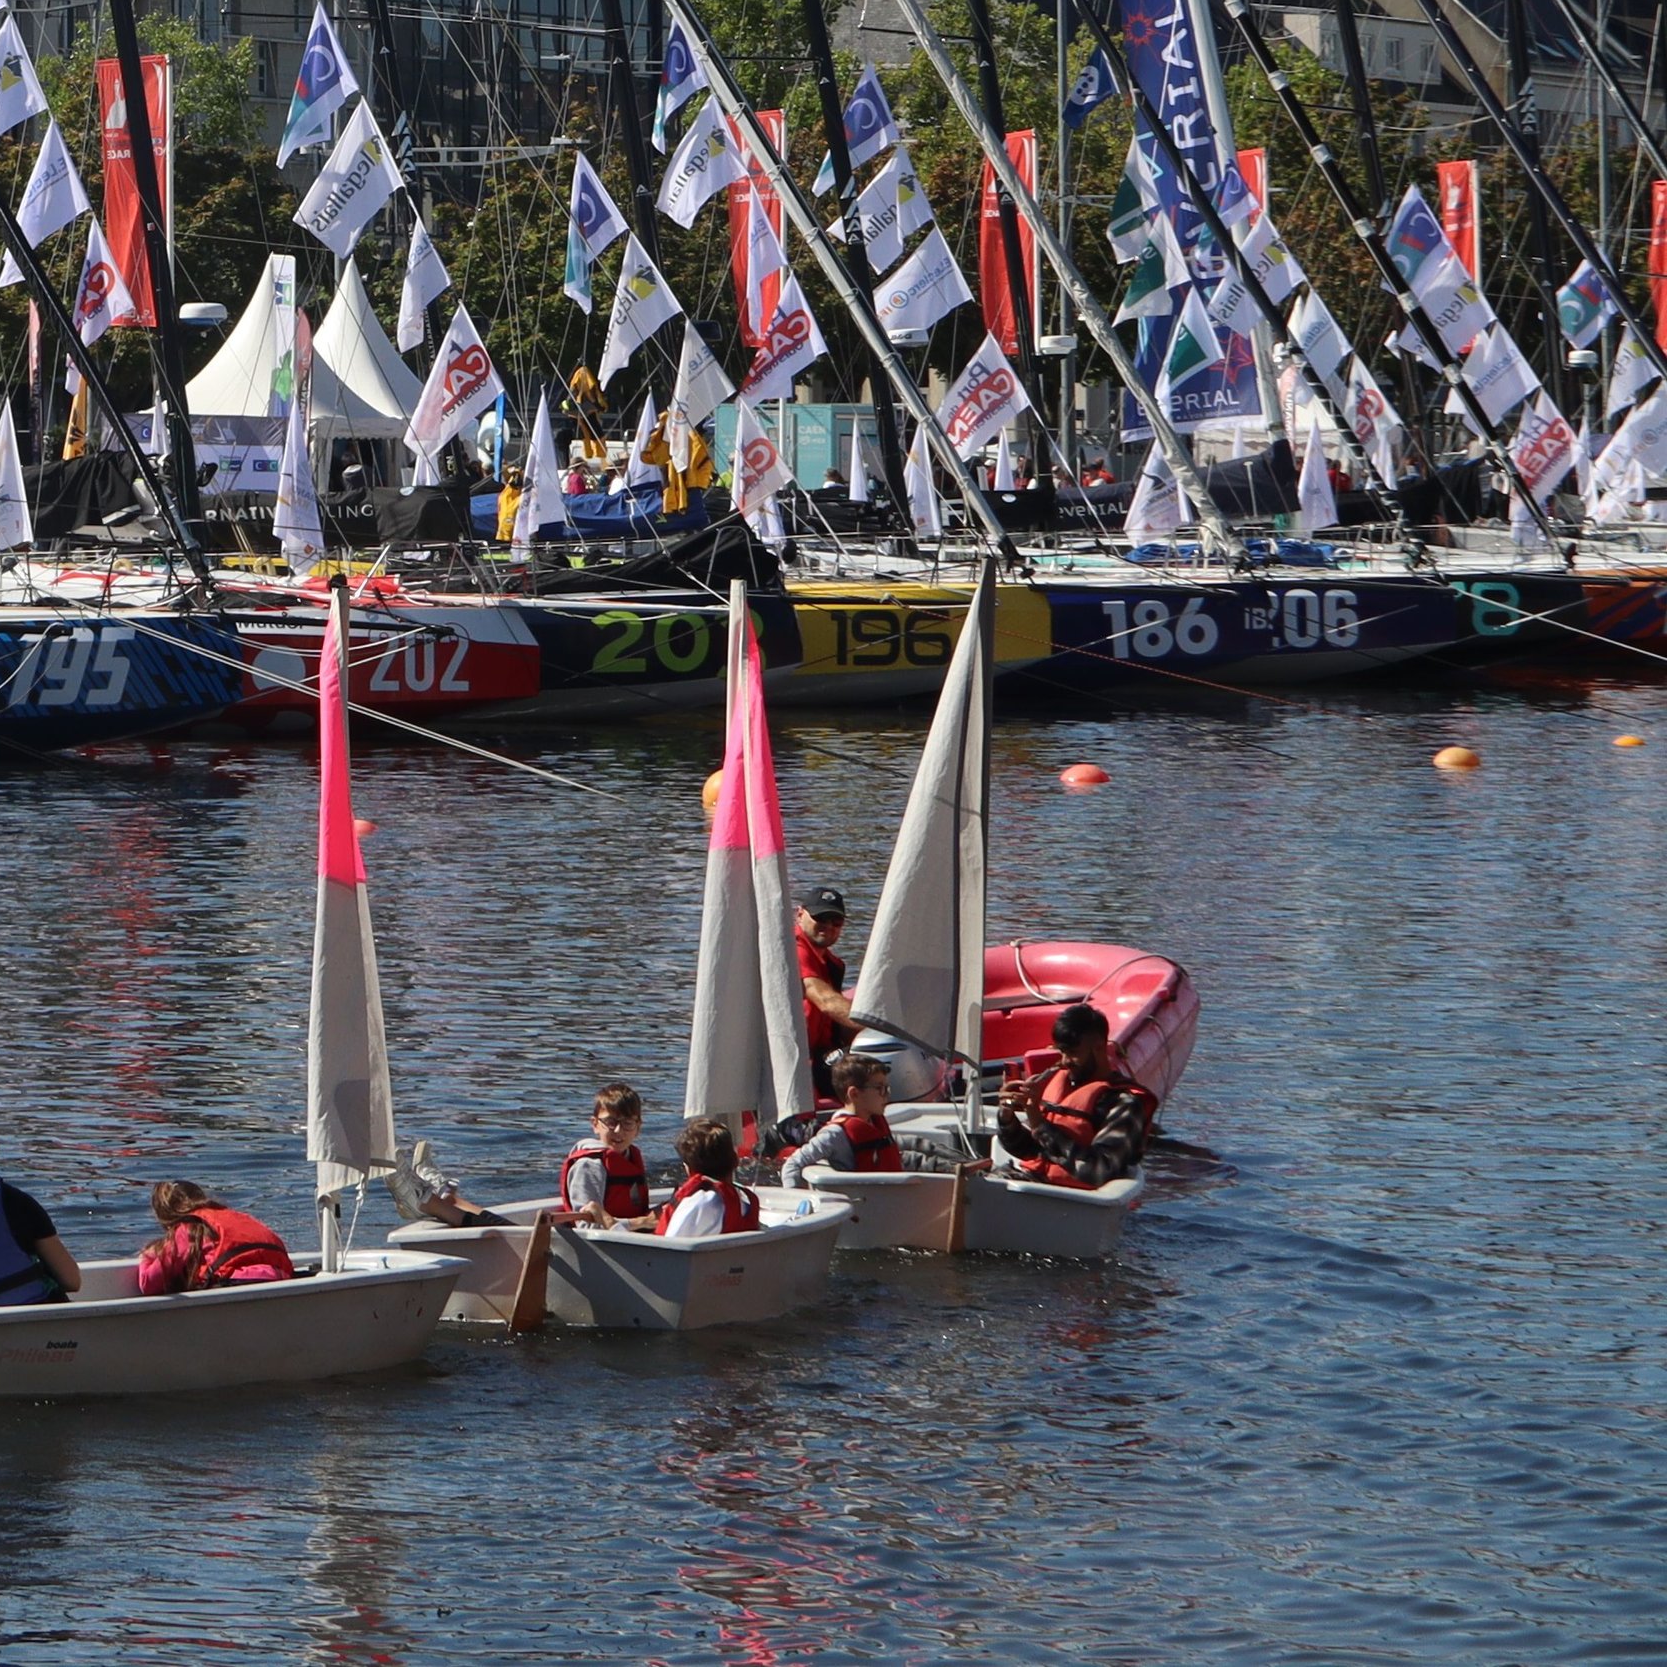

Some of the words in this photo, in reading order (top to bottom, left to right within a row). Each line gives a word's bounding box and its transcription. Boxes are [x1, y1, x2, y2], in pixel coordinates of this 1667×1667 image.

[831, 609, 951, 667] 196
[1101, 597, 1219, 660] 186
[1448, 581, 1522, 637] 8
[10, 627, 136, 706] 195
[369, 628, 471, 692] 202
